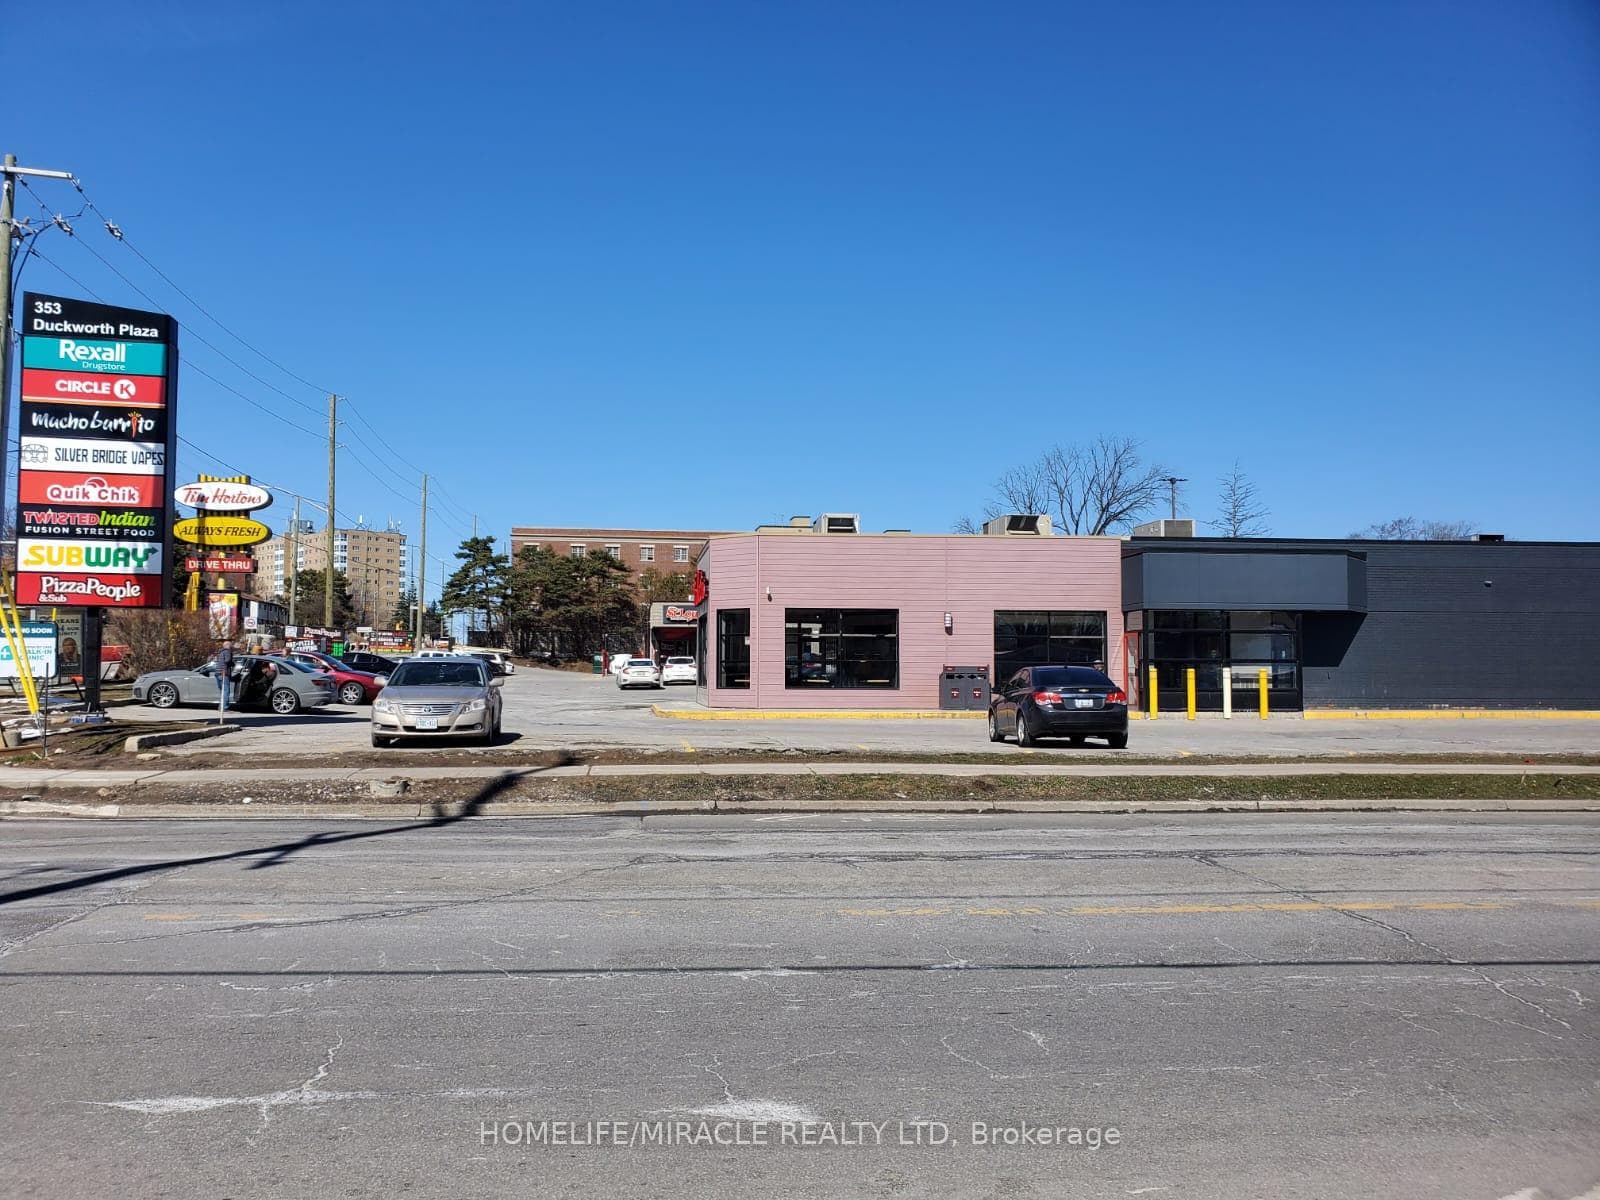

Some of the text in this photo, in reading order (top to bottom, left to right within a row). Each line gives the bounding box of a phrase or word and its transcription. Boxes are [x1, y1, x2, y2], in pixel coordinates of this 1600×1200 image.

[34, 301, 62, 315] 353
[33, 318, 159, 338] Duckworth Plaza
[59, 339, 126, 363] Rexall
[82, 361, 126, 372] Drugstore
[55, 379, 136, 400] CIRCLE K
[54, 447, 164, 466] SILVER BRIDGE VAPES
[49, 486, 137, 502] Quik Chik
[183, 487, 262, 504] Tim Hortons
[25, 526, 155, 537] FUSION STREET FOOD
[179, 525, 262, 537] ALWAYS FRESH
[23, 545, 159, 568] SUBWAY
[188, 560, 250, 570] DRIVE THRU
